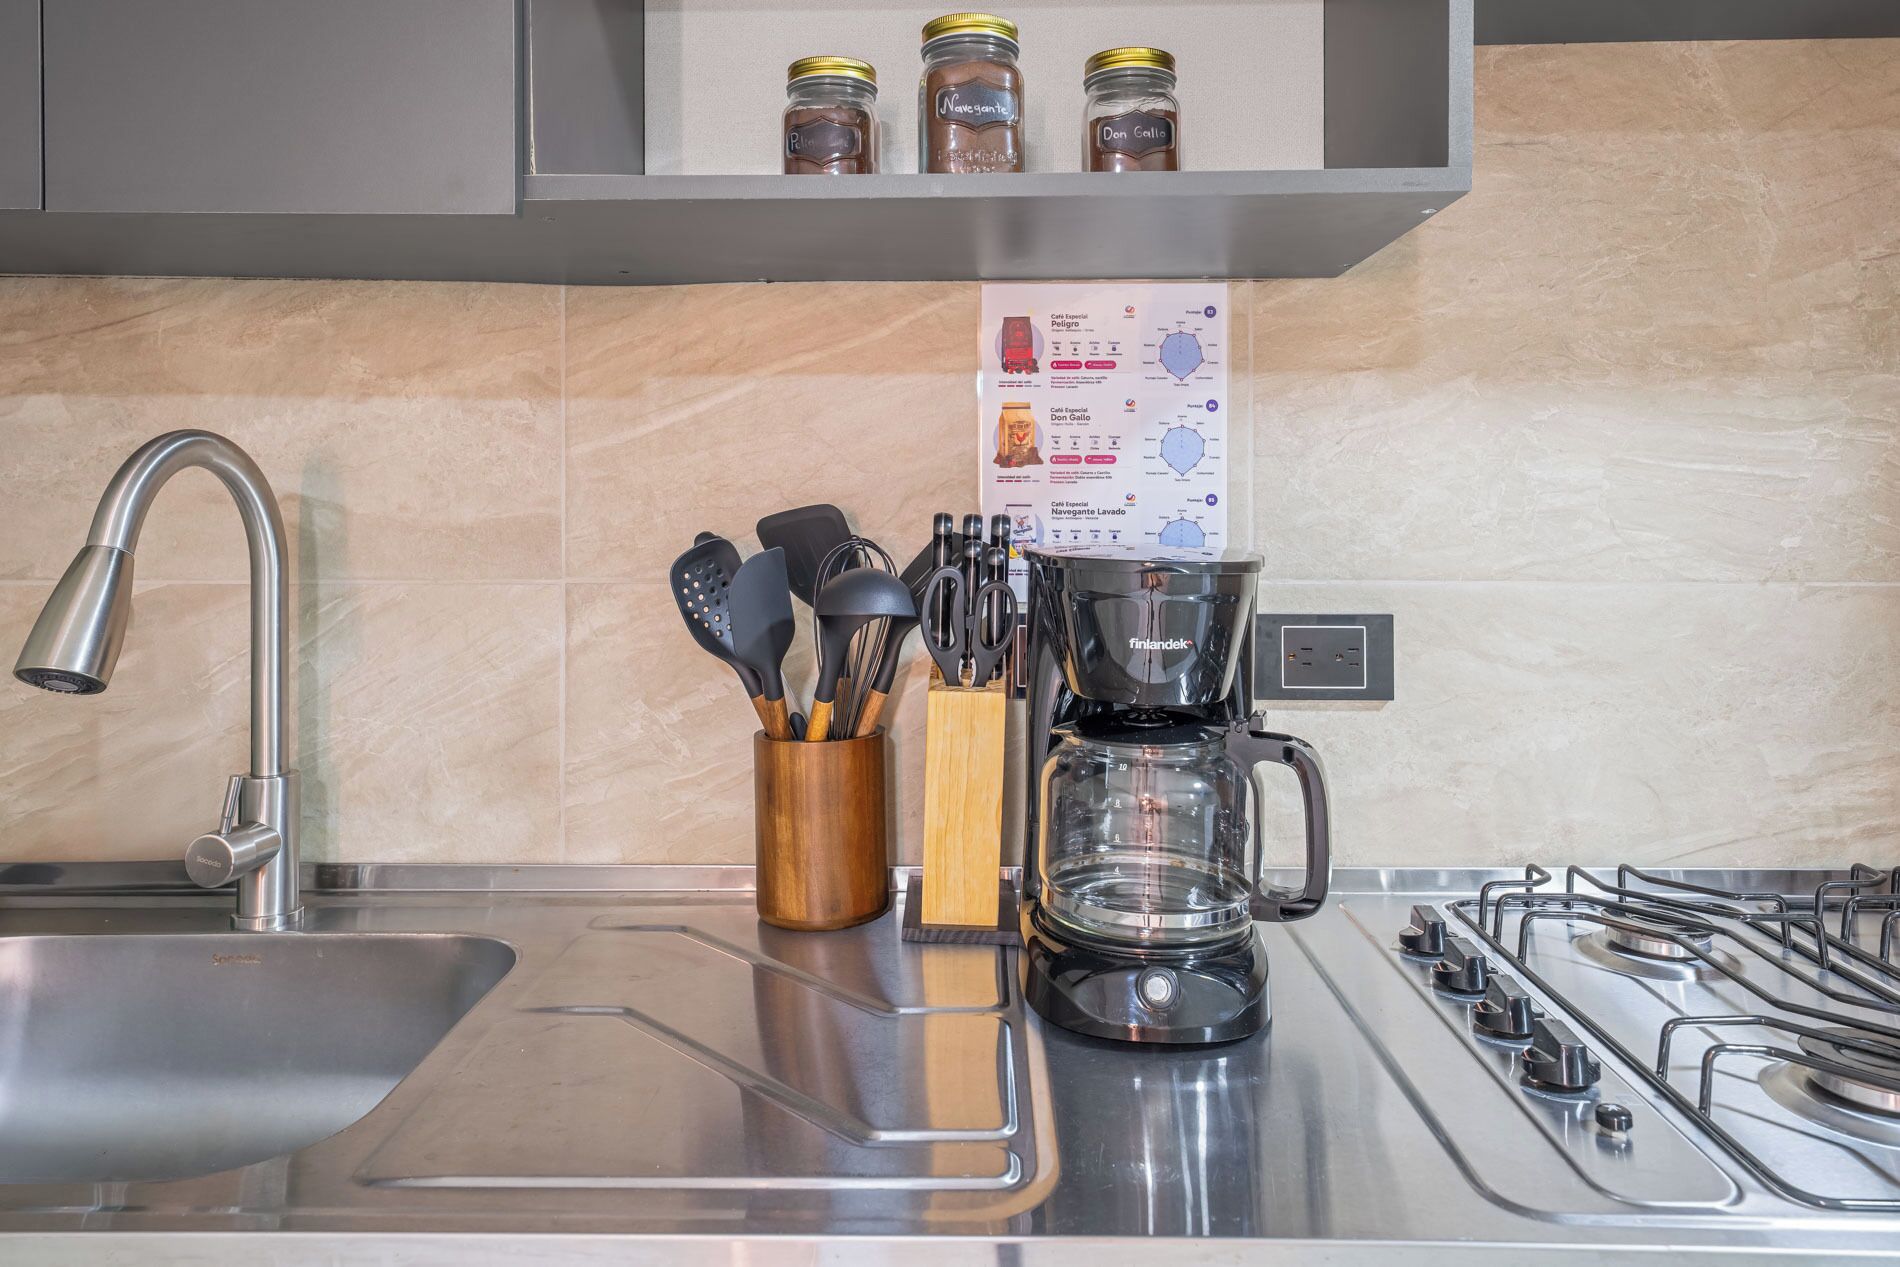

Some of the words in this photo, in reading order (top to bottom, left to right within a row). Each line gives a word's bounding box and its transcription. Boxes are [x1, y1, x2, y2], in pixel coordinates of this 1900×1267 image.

[940, 93, 1008, 115] Navegante
[1103, 126, 1127, 141] Don
[1134, 126, 1166, 139] Gallo
[1051, 320, 1080, 328] Peligro
[1051, 508, 1096, 516] Navegante
[1129, 638, 1188, 650] finlandek
